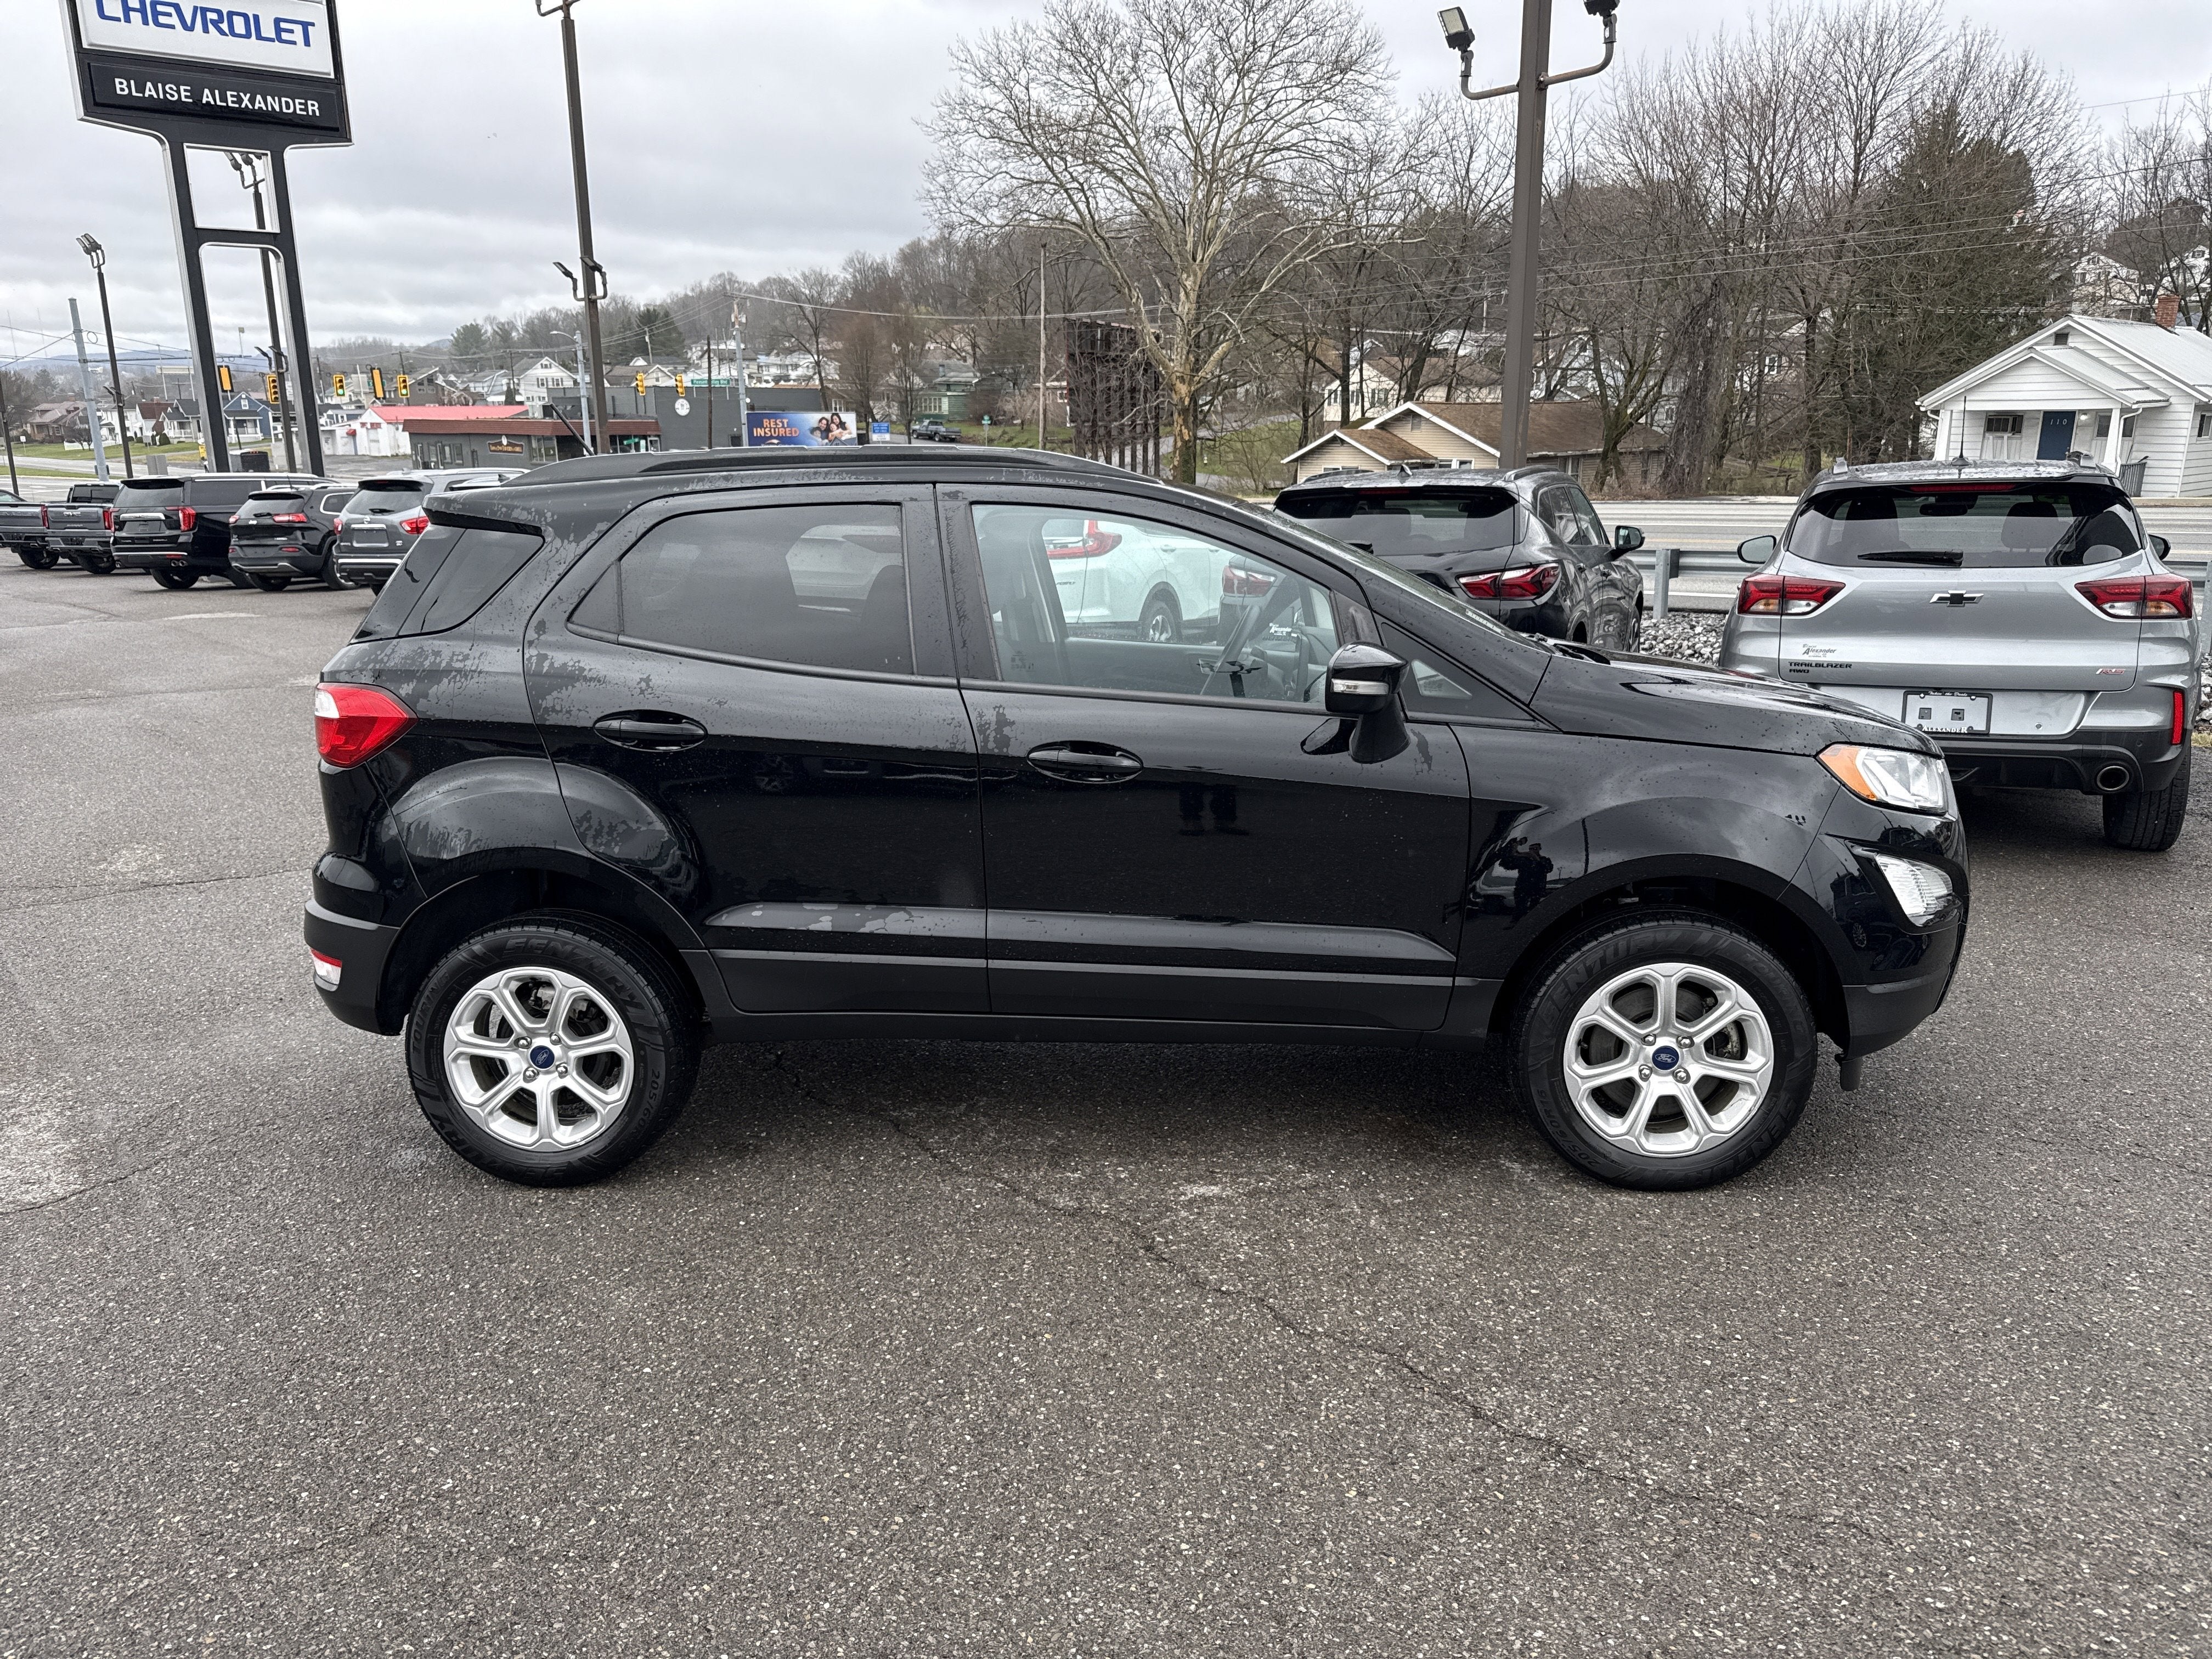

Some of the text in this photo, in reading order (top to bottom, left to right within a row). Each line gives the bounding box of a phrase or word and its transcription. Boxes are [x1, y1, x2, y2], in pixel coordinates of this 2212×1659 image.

[95, 0, 315, 47] CHEVROLET
[114, 78, 320, 116] BLAISE ALEXANDER
[763, 419, 788, 428] REST
[753, 427, 799, 437] INSURED
[1921, 725, 1968, 733] ALEXANDER
[1658, 1054, 1673, 1062] Ford
